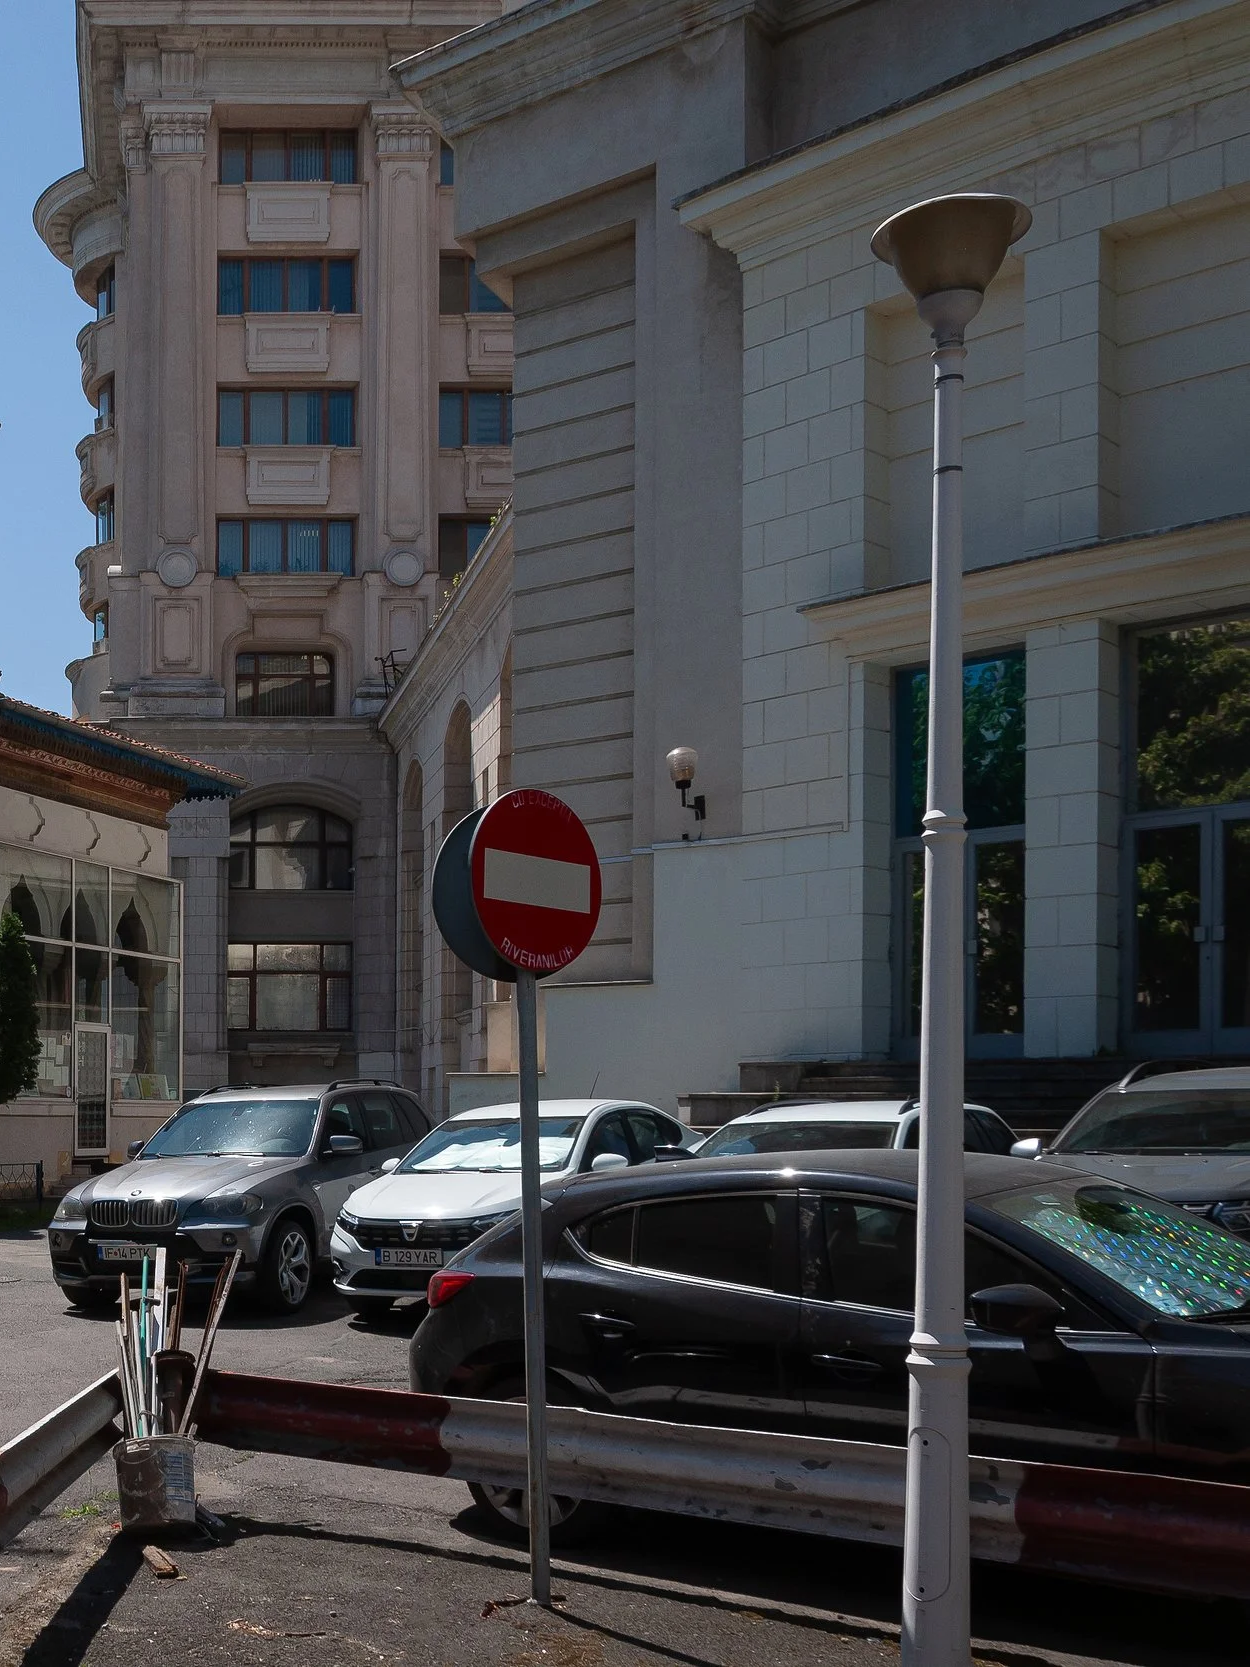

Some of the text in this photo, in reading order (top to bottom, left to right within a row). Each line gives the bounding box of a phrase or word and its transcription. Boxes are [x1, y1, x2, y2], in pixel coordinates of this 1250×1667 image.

[510, 792, 525, 808] CU
[500, 936, 574, 969] RIVERANILOR
[104, 1247, 151, 1260] IF 14 PTK
[382, 1250, 438, 1264] B 129 YAR
